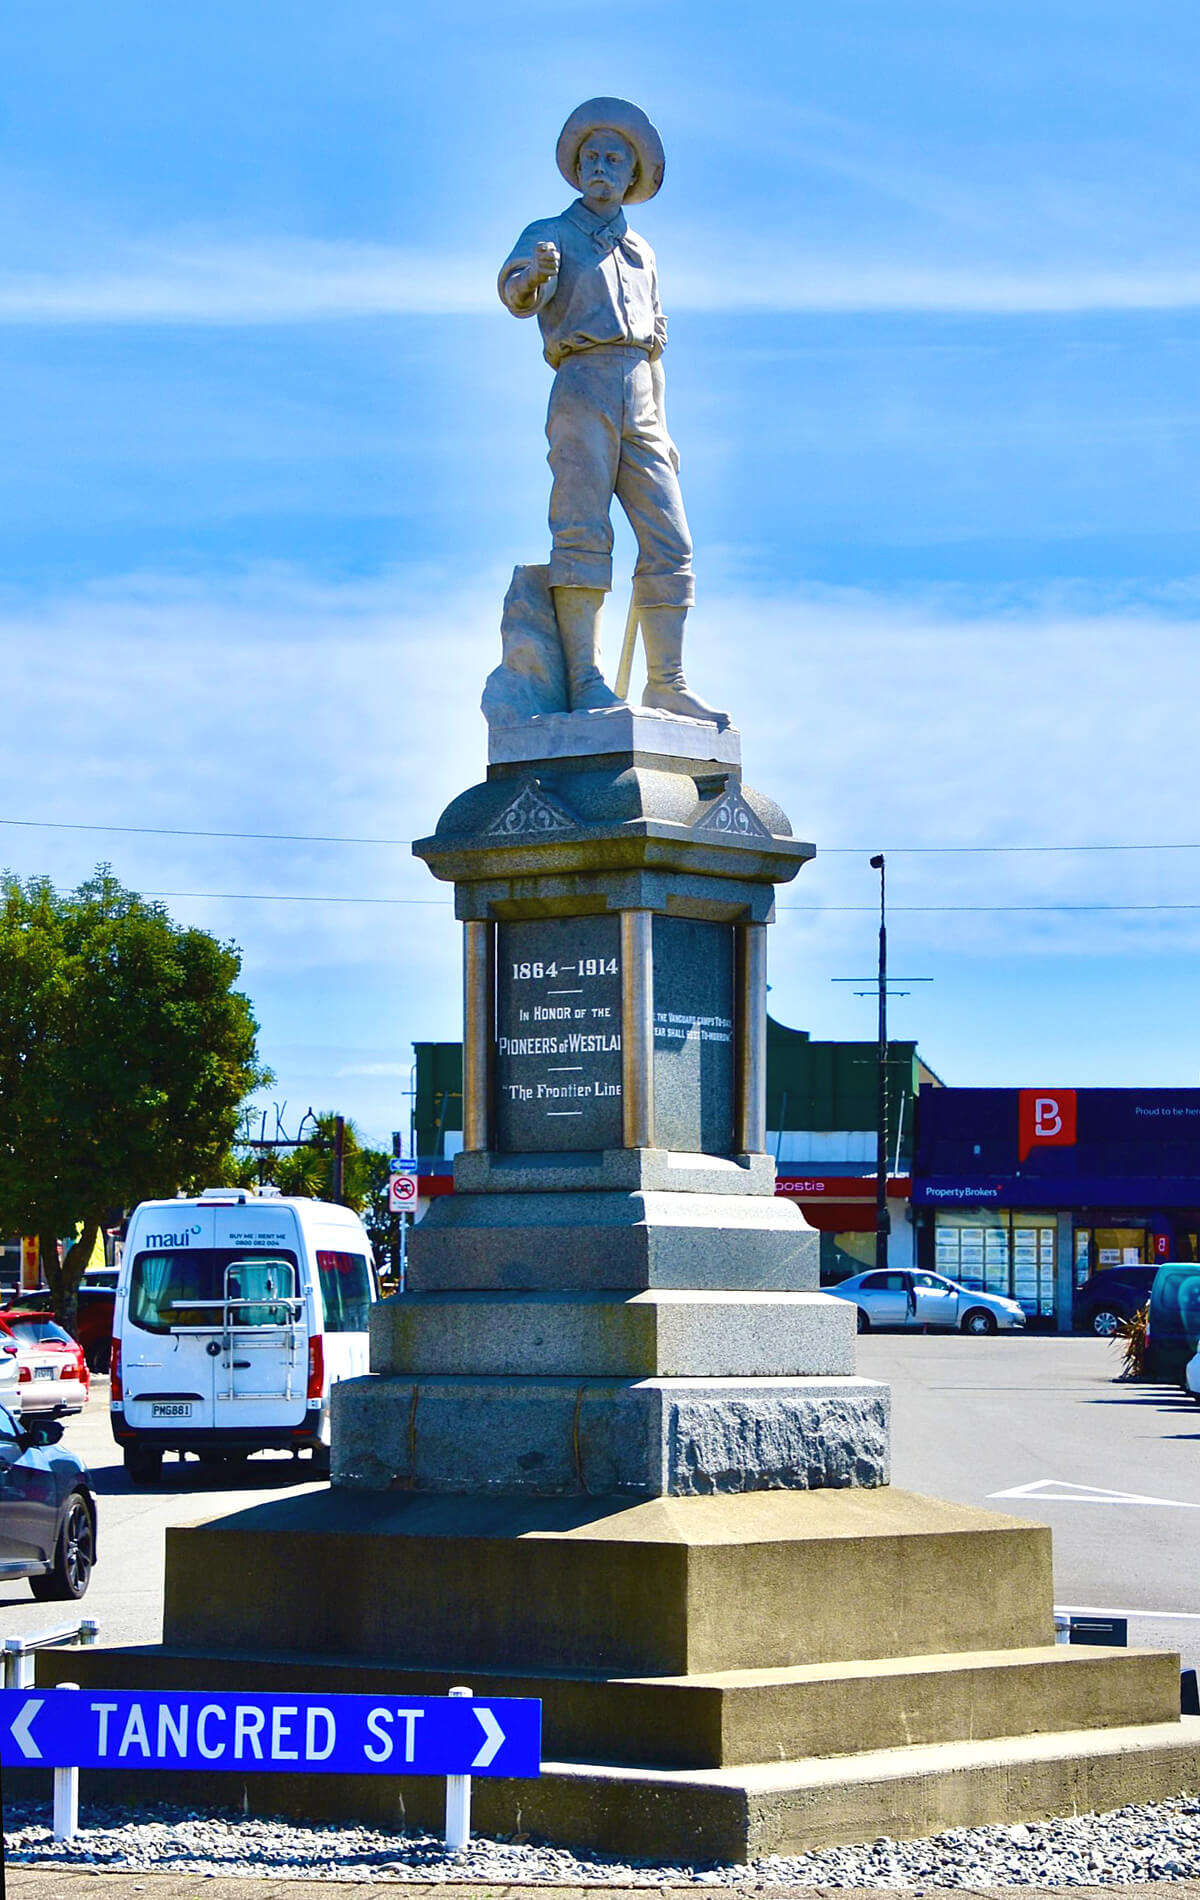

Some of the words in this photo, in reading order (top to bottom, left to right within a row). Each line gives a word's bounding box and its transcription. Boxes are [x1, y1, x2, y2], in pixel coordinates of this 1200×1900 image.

[534, 1006, 571, 1020] HONOR
[591, 1008, 611, 1017] THE
[499, 1037, 557, 1056] PIONEERS
[568, 1033, 621, 1053] WESTLA
[536, 1083, 591, 1098] Frontier
[1035, 1098, 1062, 1136] B
[1135, 1106, 1160, 1116] Proud
[1161, 1107, 1171, 1116] to
[146, 1229, 189, 1248] maui
[153, 1405, 190, 1416] PMG881
[91, 1703, 336, 1760] TANCRED
[364, 1709, 425, 1763] ST
